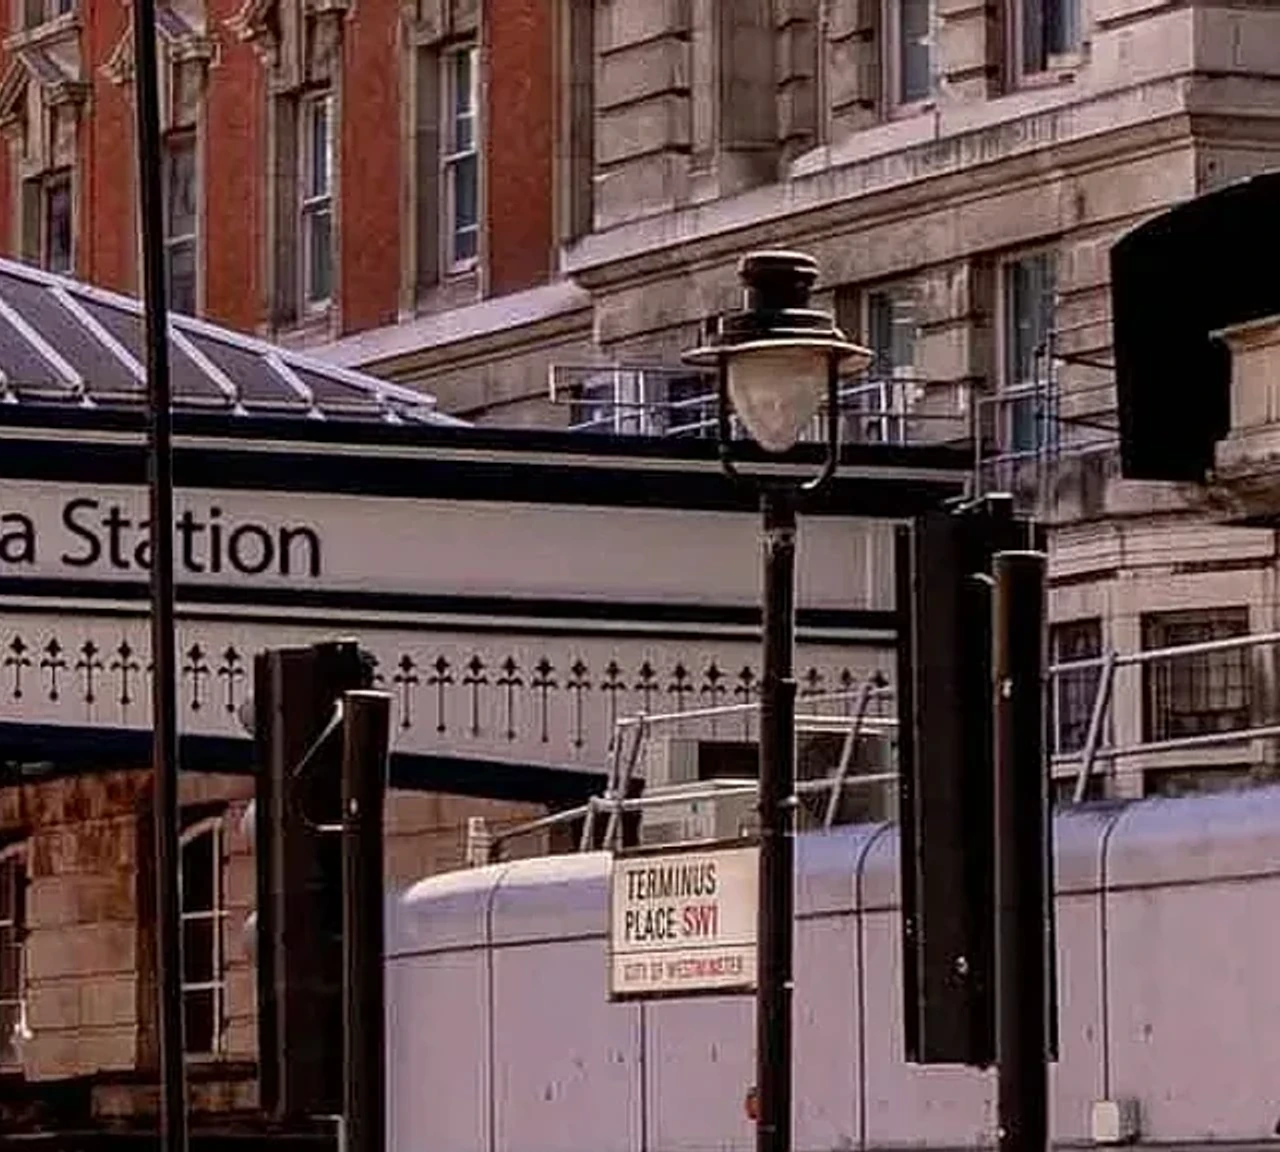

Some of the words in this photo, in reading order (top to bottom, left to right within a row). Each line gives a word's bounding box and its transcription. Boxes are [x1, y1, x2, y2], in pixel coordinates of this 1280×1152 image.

[61, 498, 321, 578] Station
[627, 862, 716, 900] TERMINUS
[625, 907, 677, 942] PLACE
[682, 904, 718, 937] SW1
